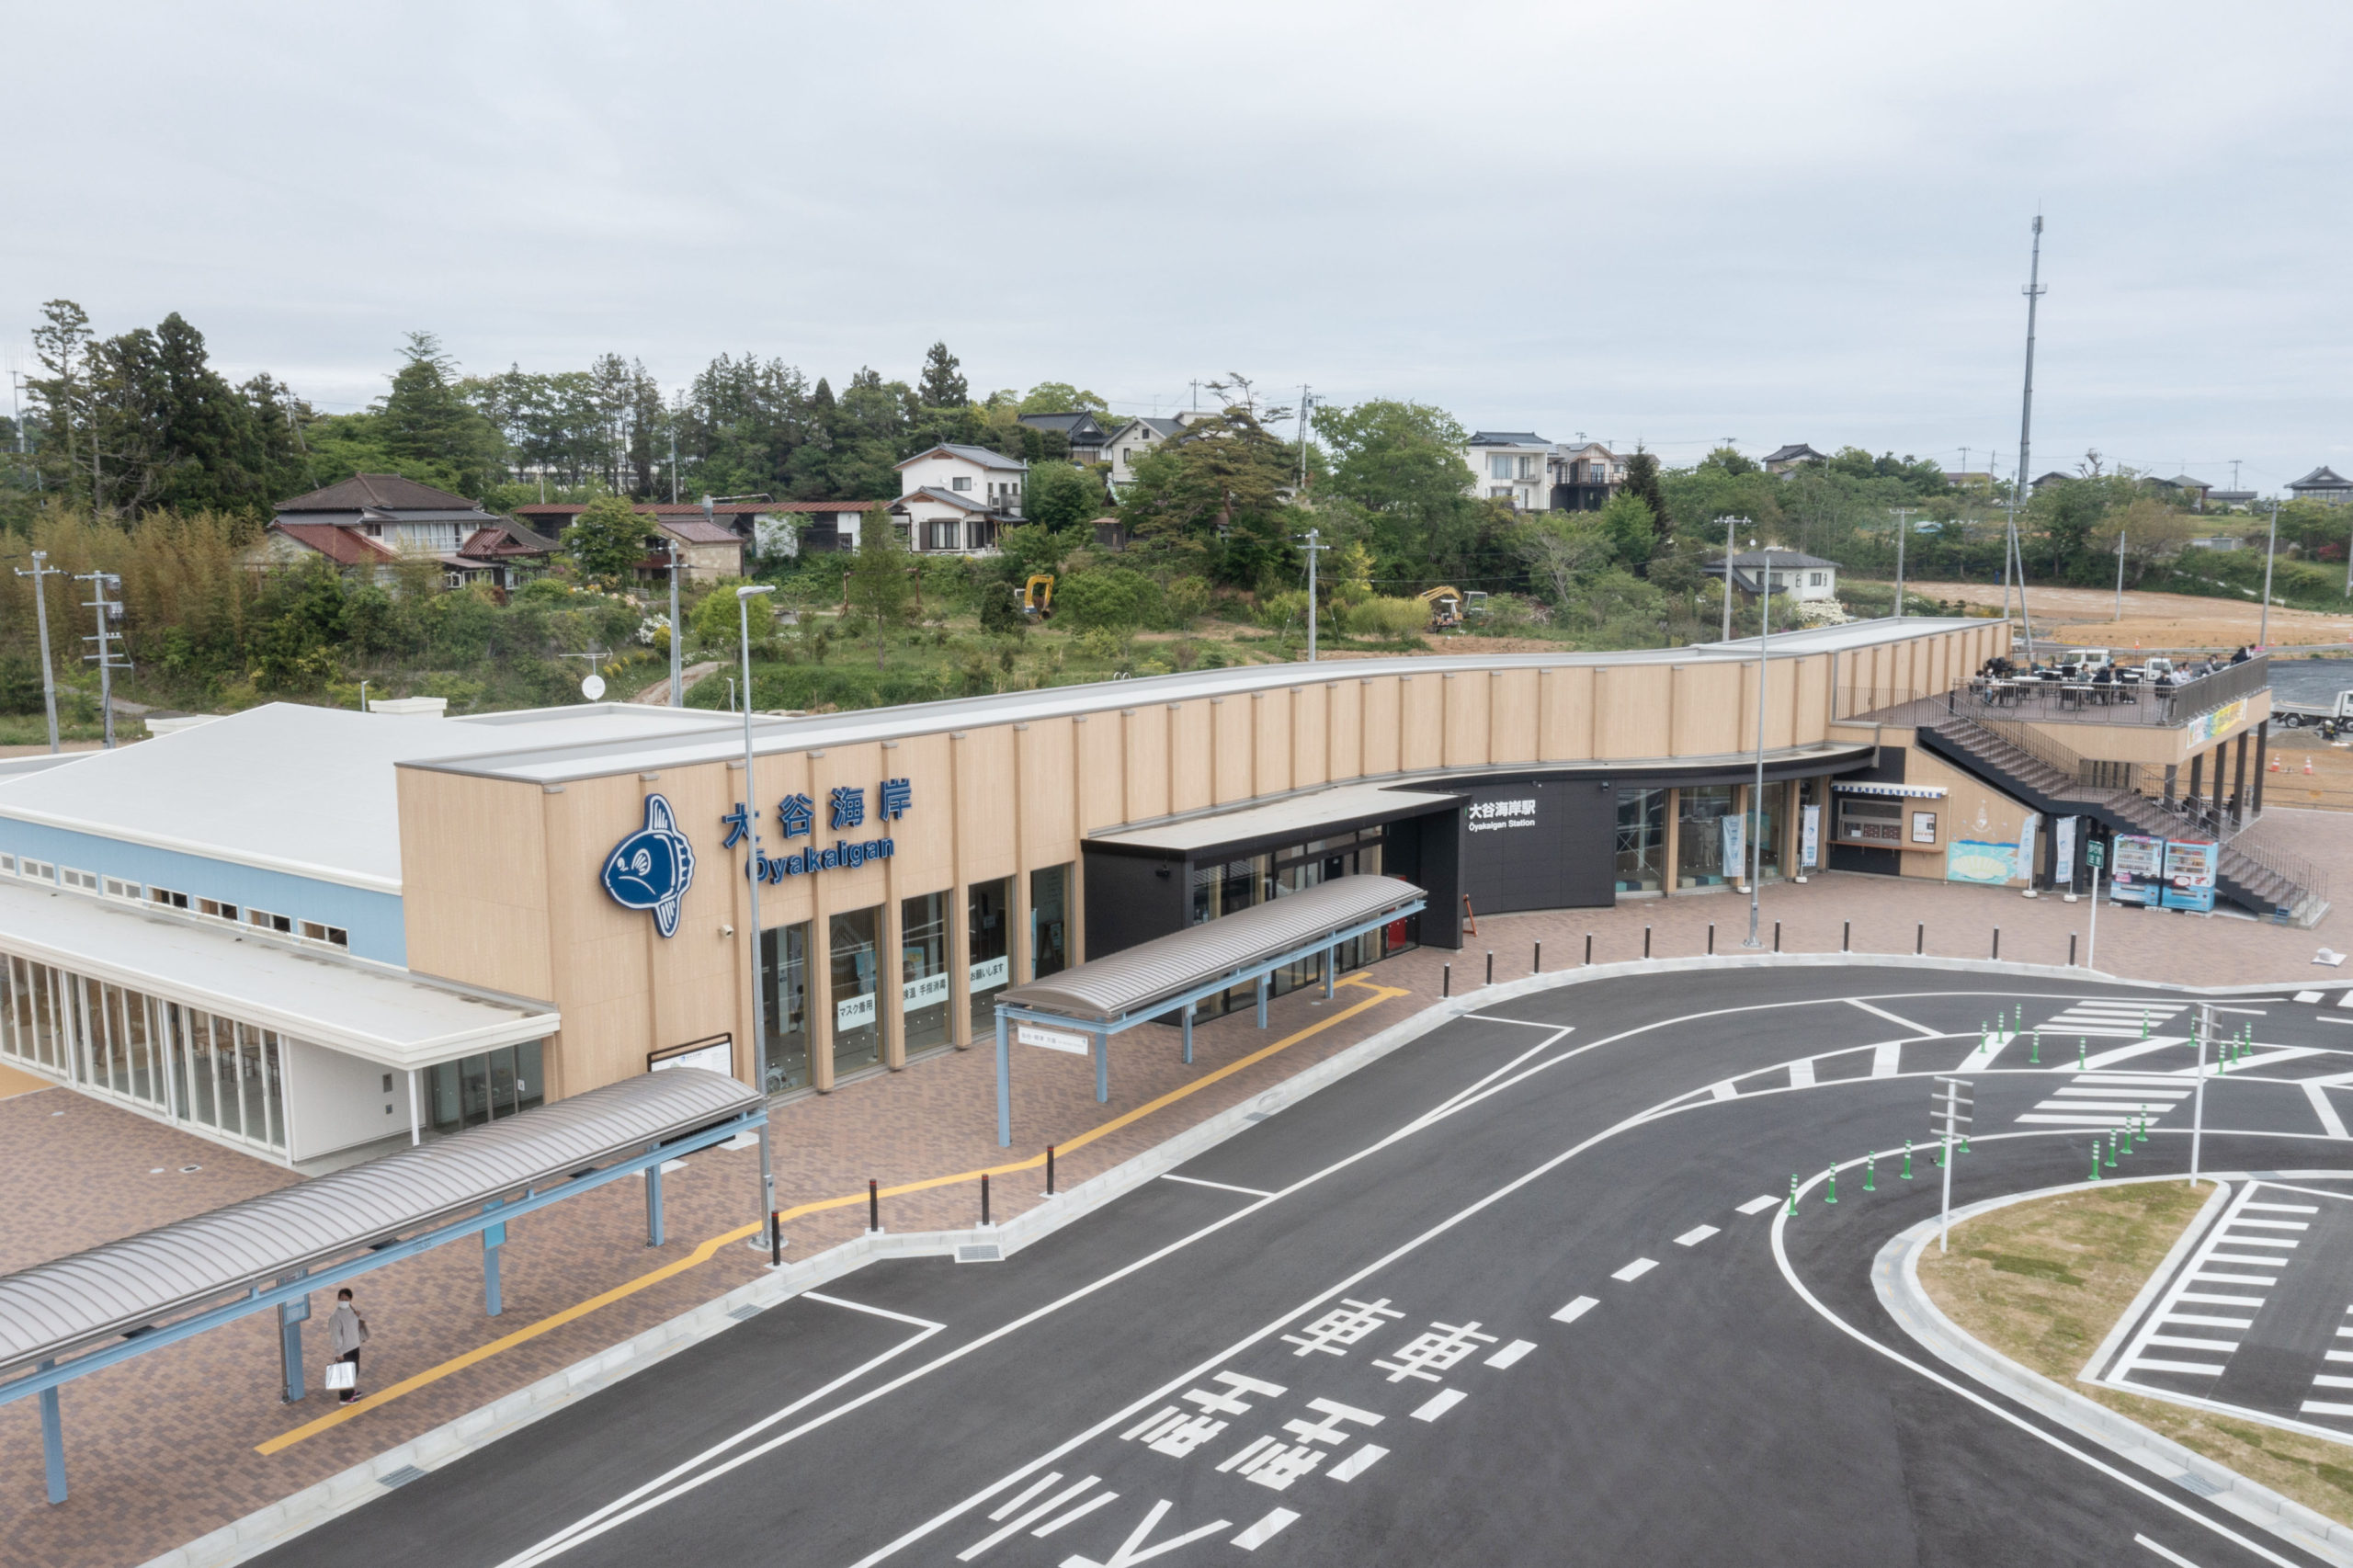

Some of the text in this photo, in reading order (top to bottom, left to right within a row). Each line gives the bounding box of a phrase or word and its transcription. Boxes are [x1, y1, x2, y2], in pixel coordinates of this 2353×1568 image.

[722, 778, 912, 849] 大谷海岸
[1469, 799, 1536, 819] 大谷海岸駅
[1508, 819, 1535, 828] Station
[970, 962, 1004, 982] お願いします
[919, 979, 947, 996] 手指消毒
[839, 999, 873, 1017] マスク着用
